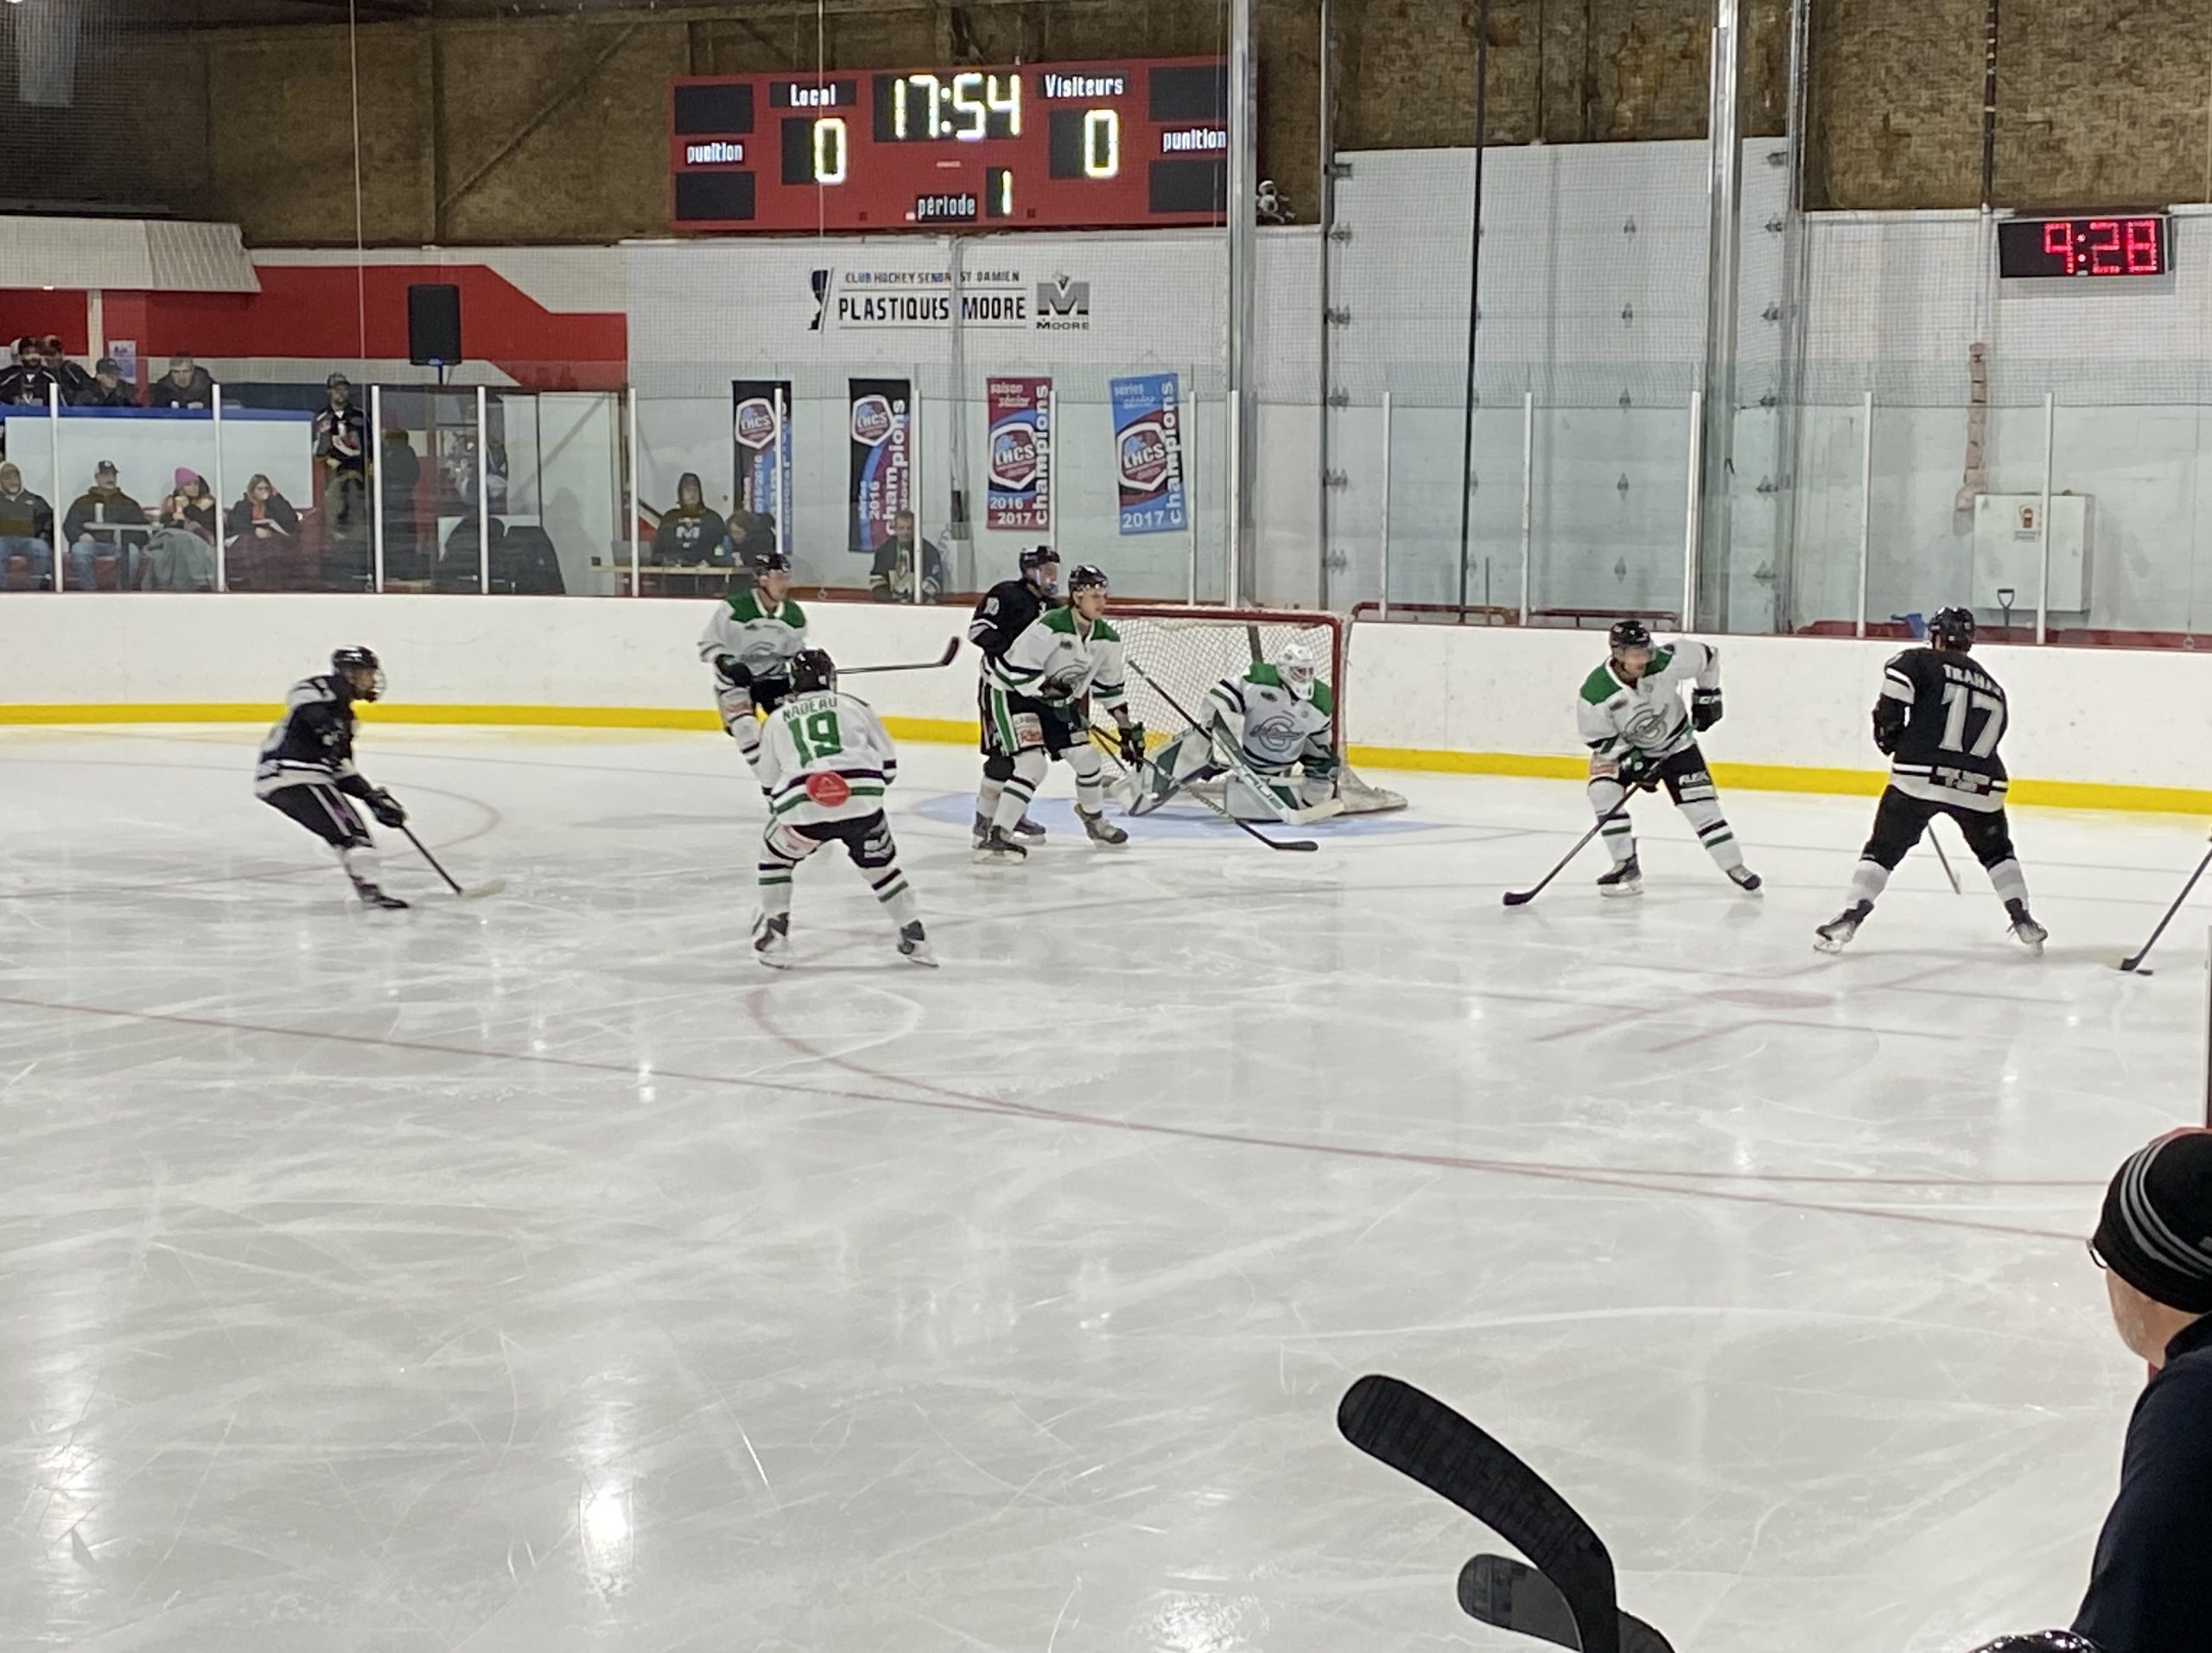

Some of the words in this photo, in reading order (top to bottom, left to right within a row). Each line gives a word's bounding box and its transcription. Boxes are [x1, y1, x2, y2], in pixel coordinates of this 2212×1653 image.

[790, 84, 836, 106] Local
[1045, 73, 1123, 98] Visiteurs
[893, 72, 1021, 142] 17:54
[687, 142, 743, 164] punition
[814, 118, 847, 185] 0
[1084, 109, 1119, 178] 0
[1163, 128, 1227, 153] punition
[1001, 169, 1012, 215] 1
[918, 194, 976, 220] période
[2044, 219, 2157, 274] 9:28
[845, 272, 872, 284] CLUB
[874, 272, 916, 284] HOCKEY
[976, 270, 1020, 283] DAMIEN
[838, 297, 950, 321] PLASTIQUES
[961, 296, 1027, 320] MOORE
[1036, 321, 1090, 330] MOORE
[995, 443, 1035, 467] LHCS
[1033, 385, 1050, 525] champions
[1123, 443, 1165, 469] LHCS
[1161, 380, 1182, 525] champions
[869, 480, 880, 520] 2016
[989, 497, 1024, 510] 2016
[998, 512, 1033, 525] 2017
[1123, 510, 1165, 529] 2017
[783, 696, 838, 722] NADEAU
[1938, 682, 2005, 759] 17
[787, 709, 844, 768] 19
